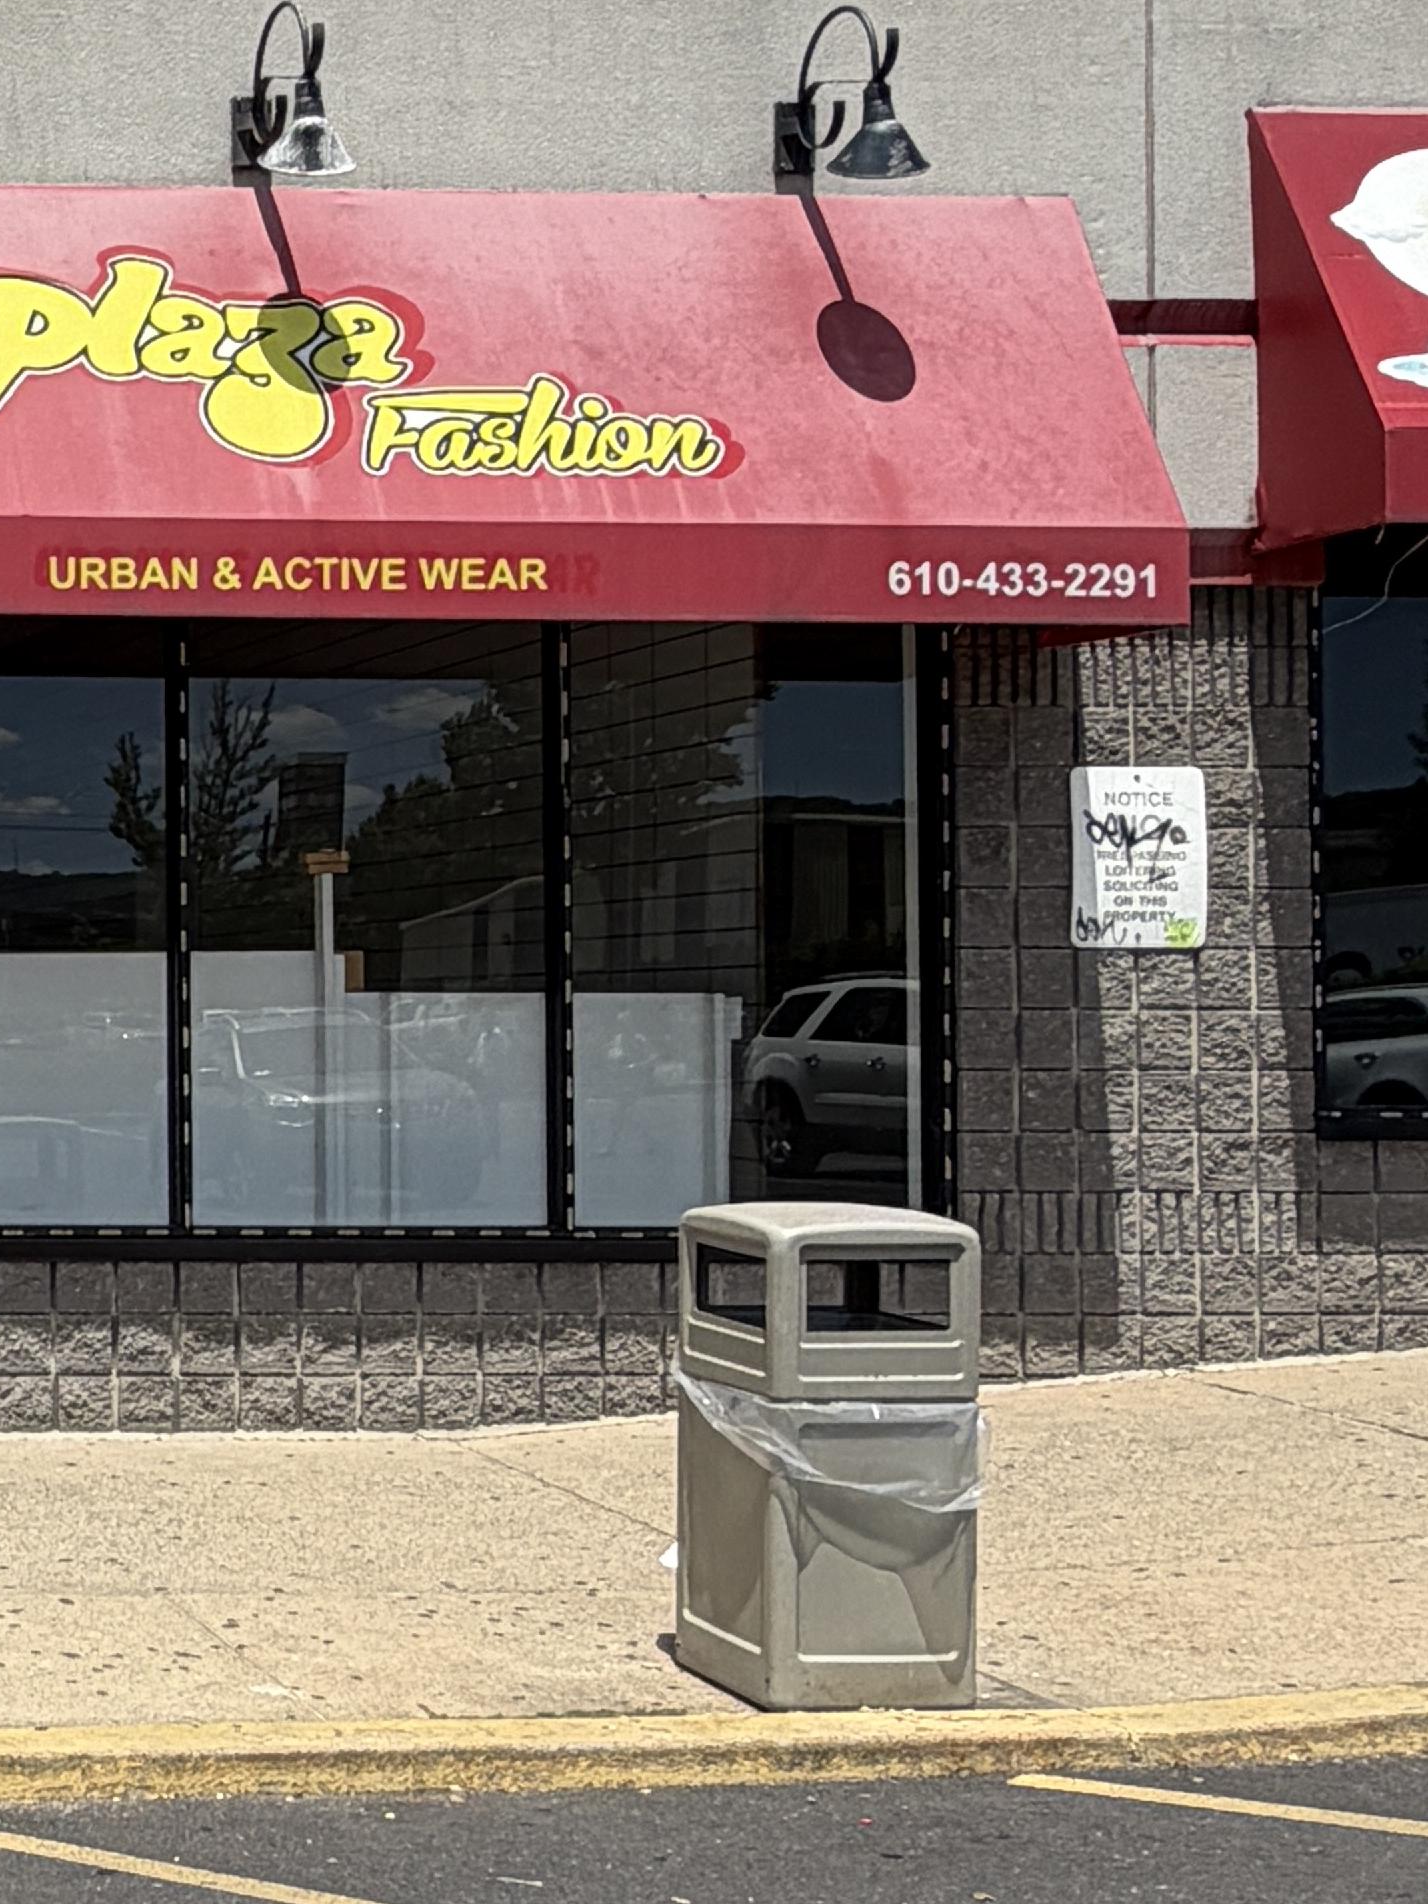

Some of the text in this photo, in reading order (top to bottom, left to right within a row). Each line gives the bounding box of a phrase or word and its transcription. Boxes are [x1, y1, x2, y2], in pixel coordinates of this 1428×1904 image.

[360, 371, 728, 477] Fashion
[48, 555, 549, 592] URBAN & ACTIVE WEAR
[887, 560, 1158, 599] 610-433-2291
[1103, 791, 1174, 807] NOTICE
[1112, 895, 1168, 906] ON THIS
[1103, 910, 1176, 922] PROPERTY
